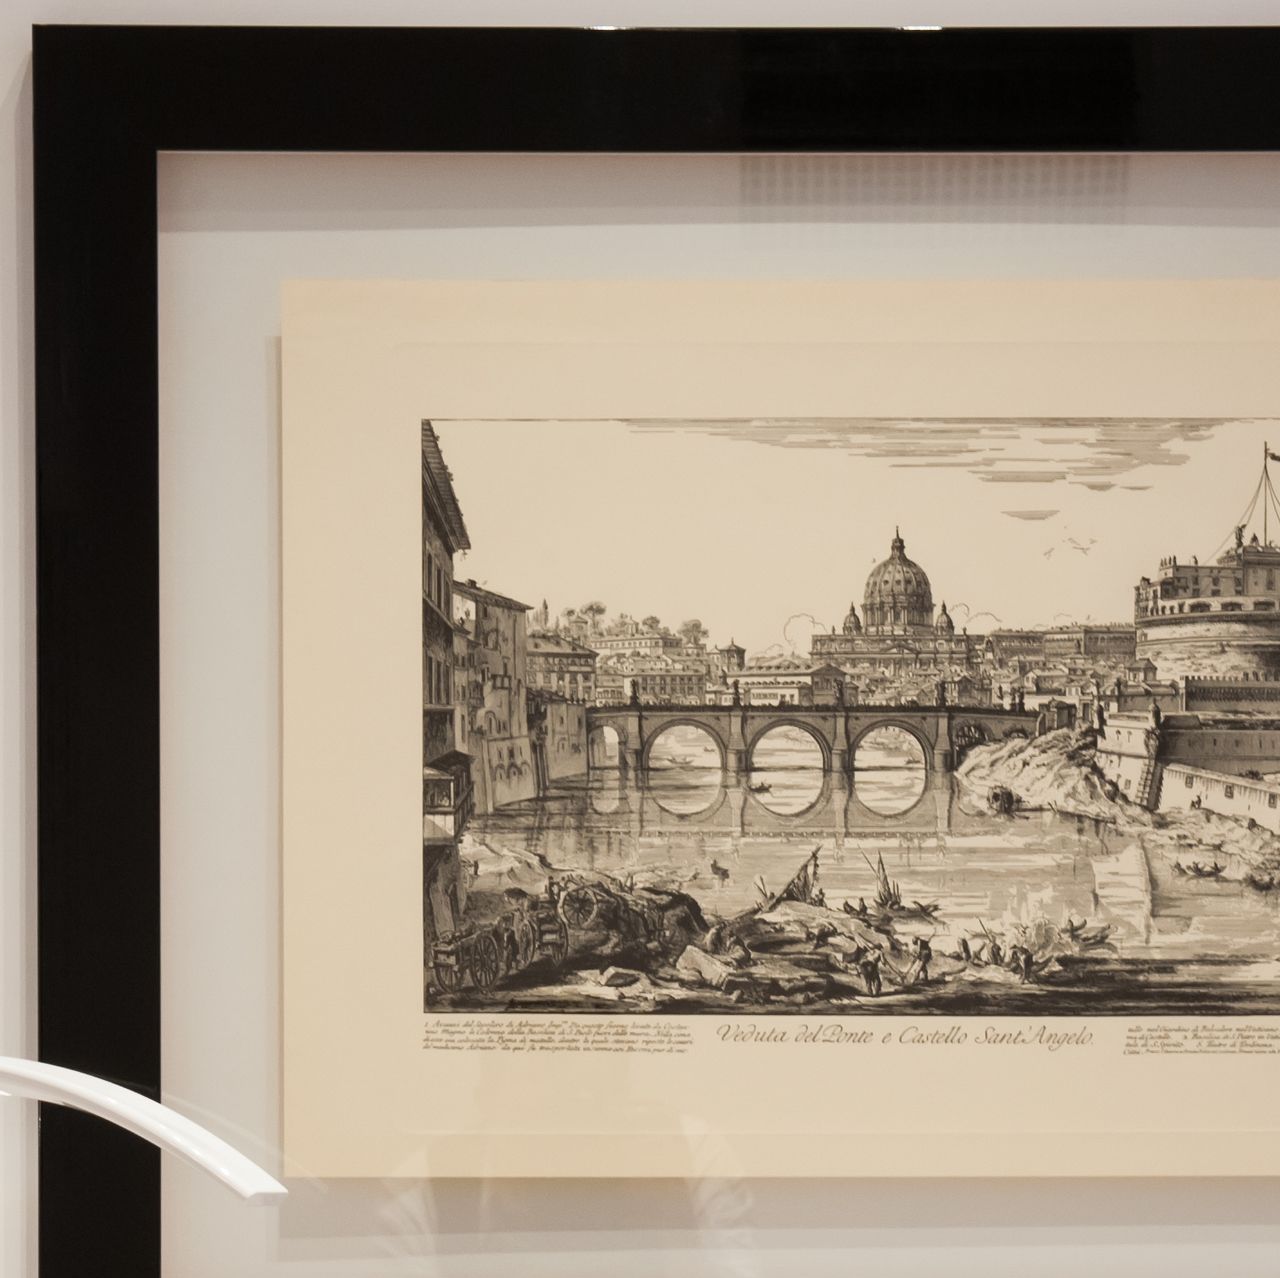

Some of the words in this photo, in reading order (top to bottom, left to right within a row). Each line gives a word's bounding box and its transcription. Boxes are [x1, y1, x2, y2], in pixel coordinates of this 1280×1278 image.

[716, 1023, 790, 1043] Veduta
[795, 1024, 823, 1043] del
[822, 1024, 874, 1044] Ponte
[882, 1031, 892, 1044] e
[898, 1025, 968, 1045] Castello
